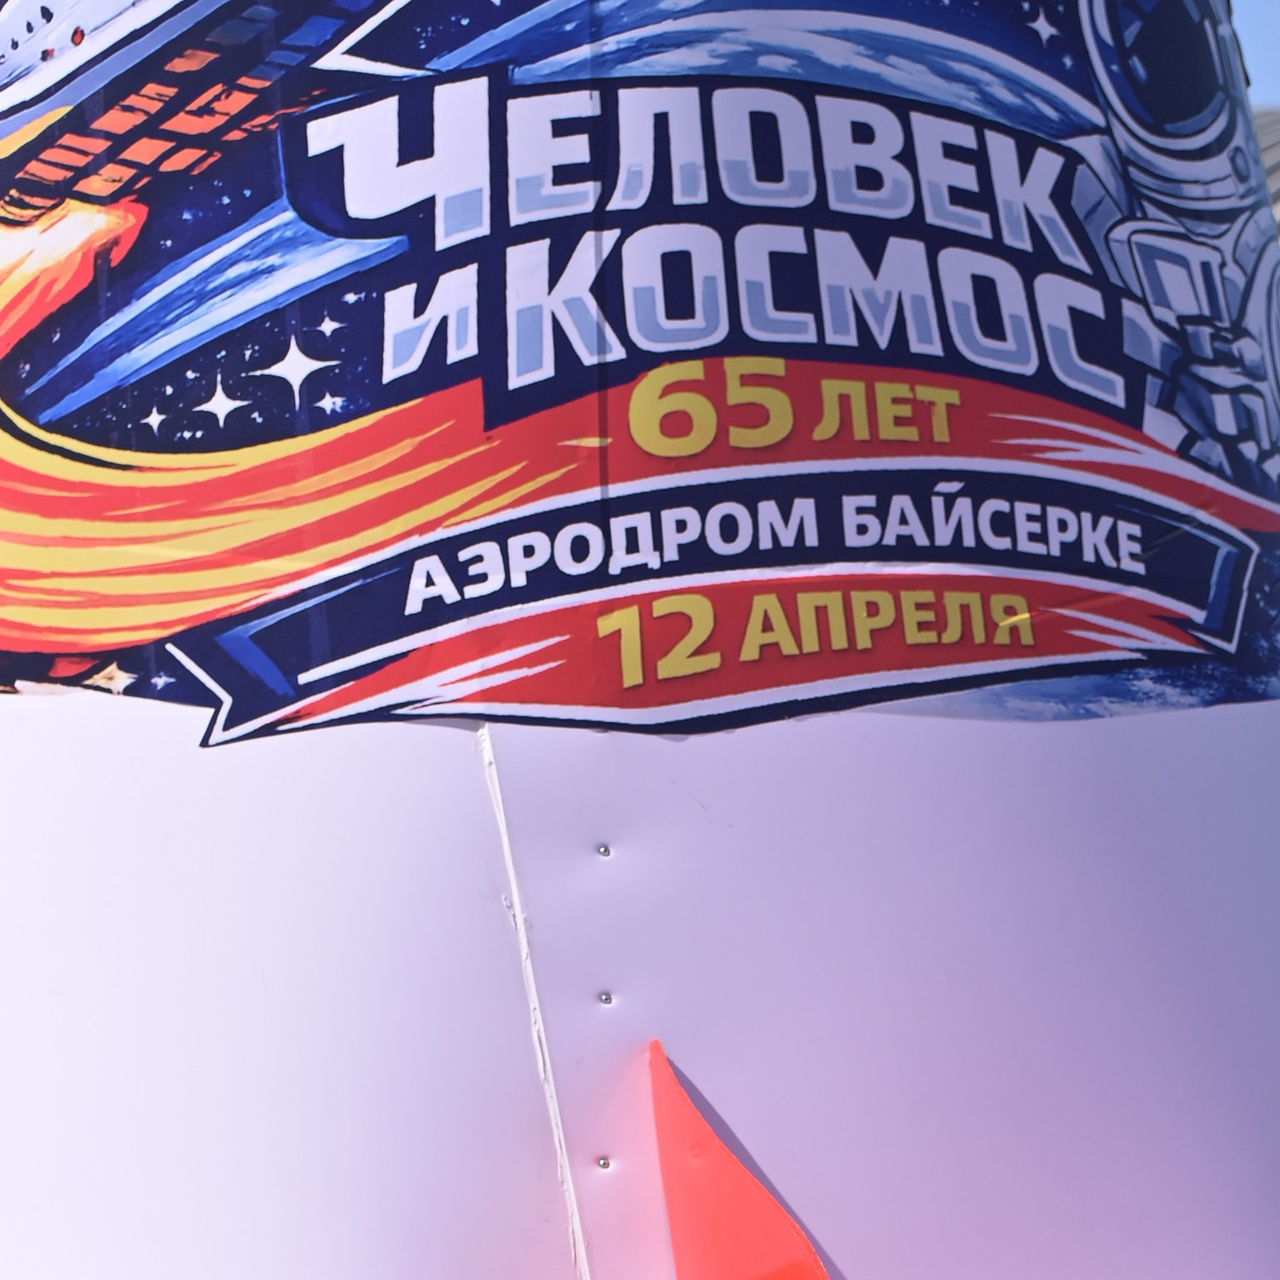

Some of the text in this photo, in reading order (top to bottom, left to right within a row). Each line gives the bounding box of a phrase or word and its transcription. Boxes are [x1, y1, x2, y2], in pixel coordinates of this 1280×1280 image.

[306, 76, 1093, 276] ЧЕЛОВЕК
[505, 222, 1126, 409] КОСМОС
[628, 356, 961, 458] 65 ЛЕТ
[404, 481, 1147, 616] АЭРОДРОМ БАЙСЕРКЕ
[597, 591, 1035, 690] 12 АПРЕЛЯ
